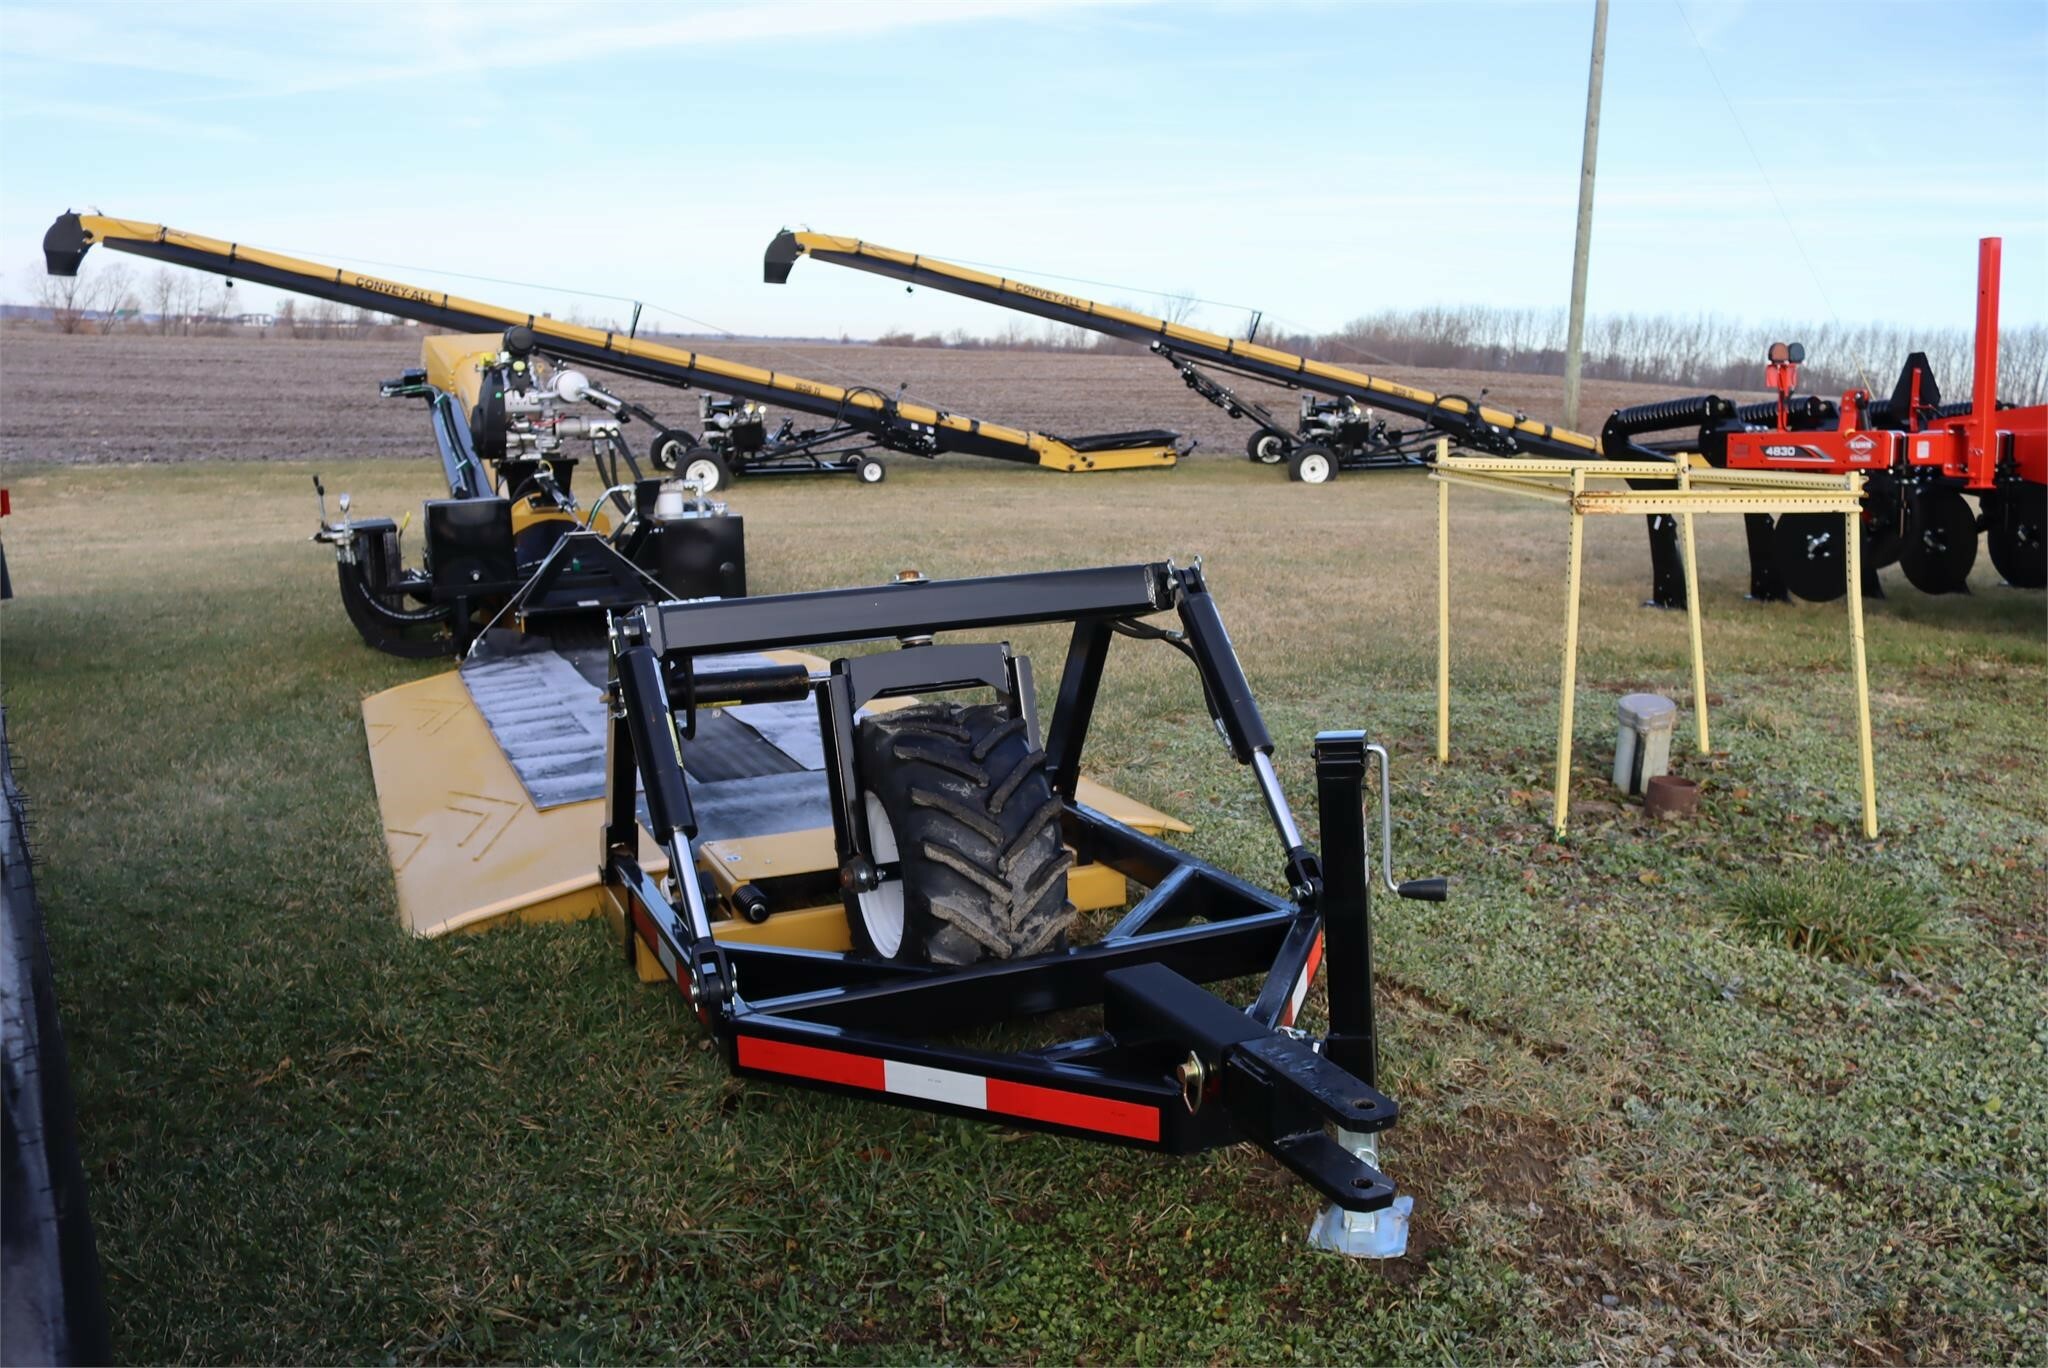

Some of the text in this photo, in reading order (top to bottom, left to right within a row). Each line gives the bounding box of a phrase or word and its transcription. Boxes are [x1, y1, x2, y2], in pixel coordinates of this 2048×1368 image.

[355, 276, 434, 304] CONVEY-ALL
[1015, 283, 1081, 308] CONVEY-ALL
[1765, 446, 1796, 457] 4830
